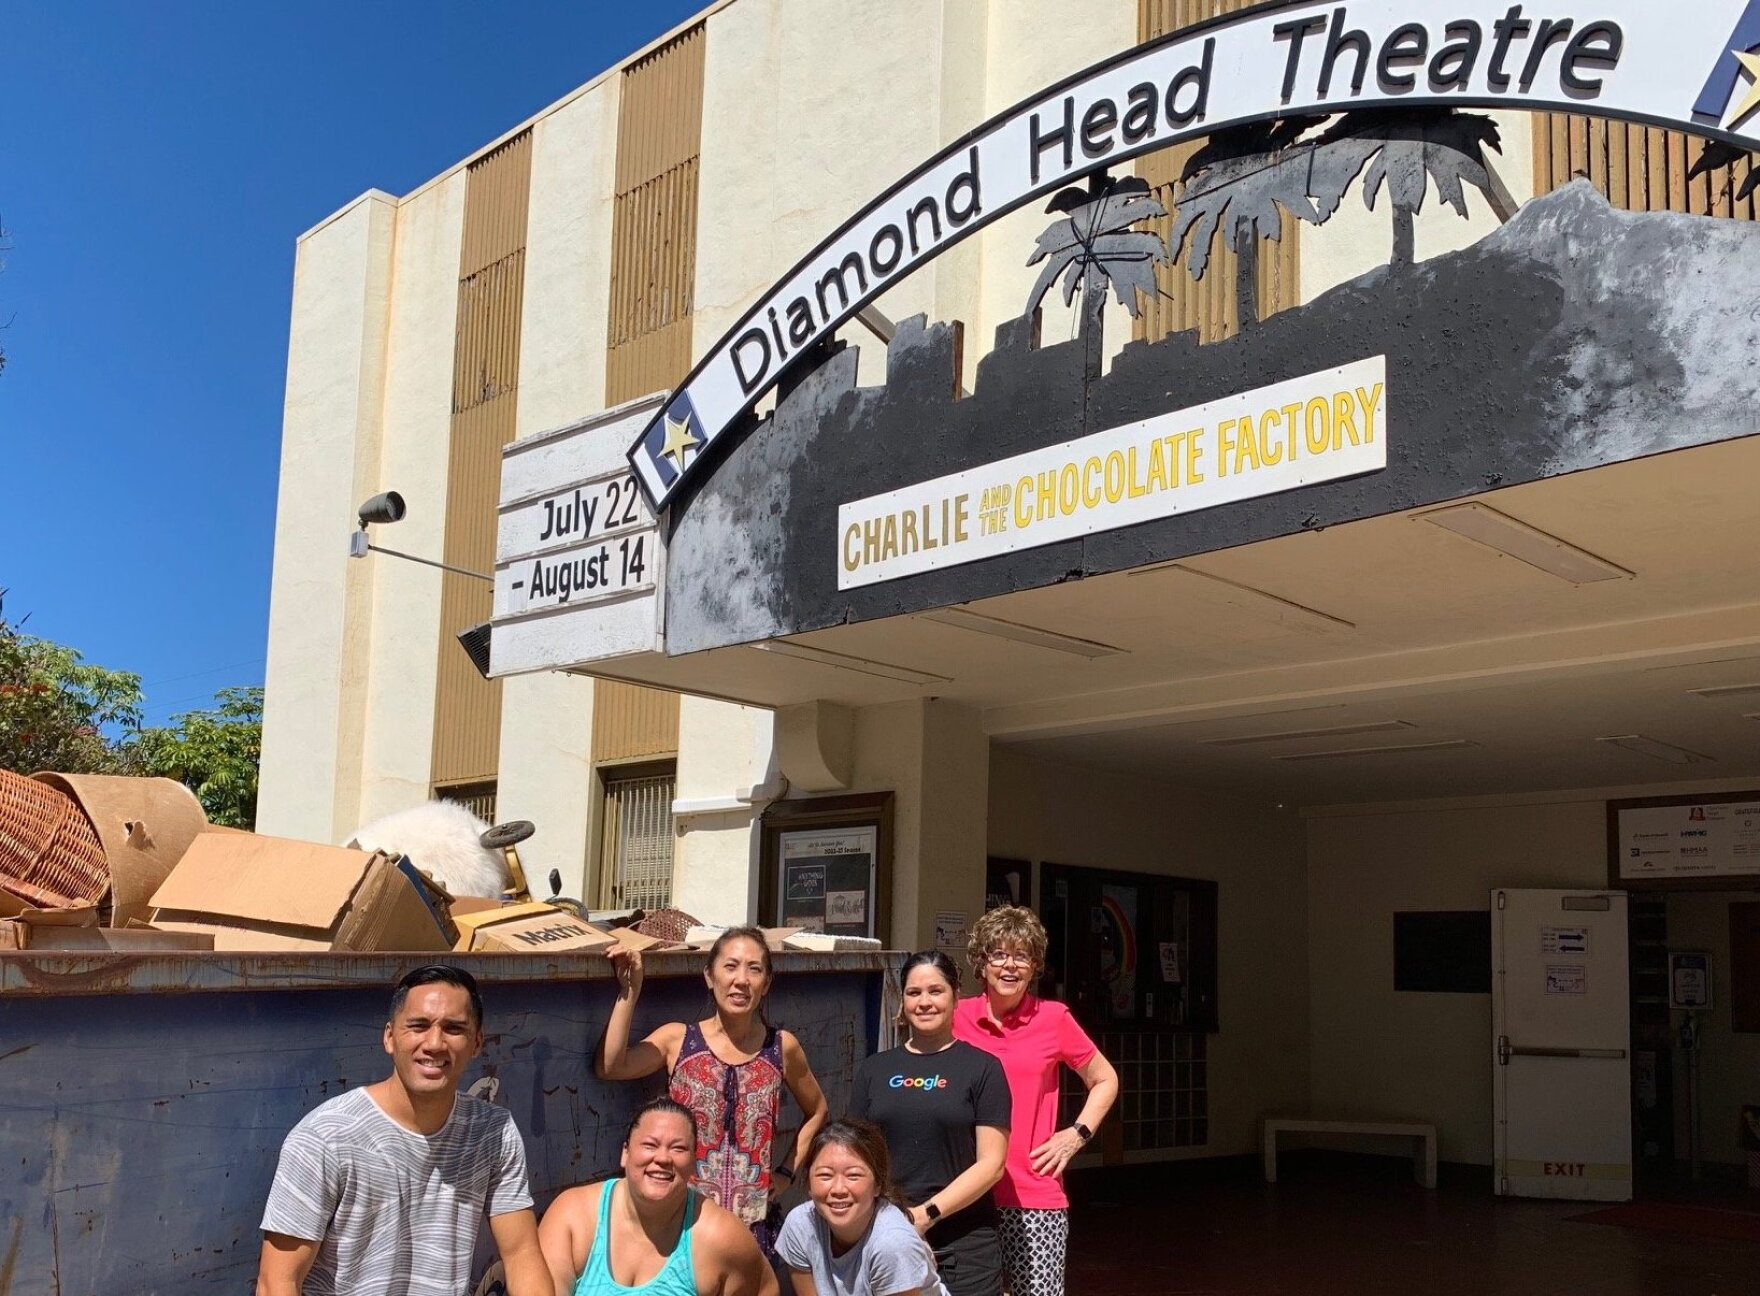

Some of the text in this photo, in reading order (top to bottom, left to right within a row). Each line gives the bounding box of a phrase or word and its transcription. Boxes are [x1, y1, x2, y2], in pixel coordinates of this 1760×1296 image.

[730, 4, 1624, 397] Diamond Head Theatre
[540, 476, 639, 541] July 22
[843, 382, 1384, 572] CHARLIE AND THE CHOCOLATE FACTORY
[529, 545, 610, 603] August
[619, 535, 645, 587] 14
[512, 923, 593, 946] Matrix
[888, 1074, 948, 1091] Google
[1543, 1163, 1585, 1176] EXIT
